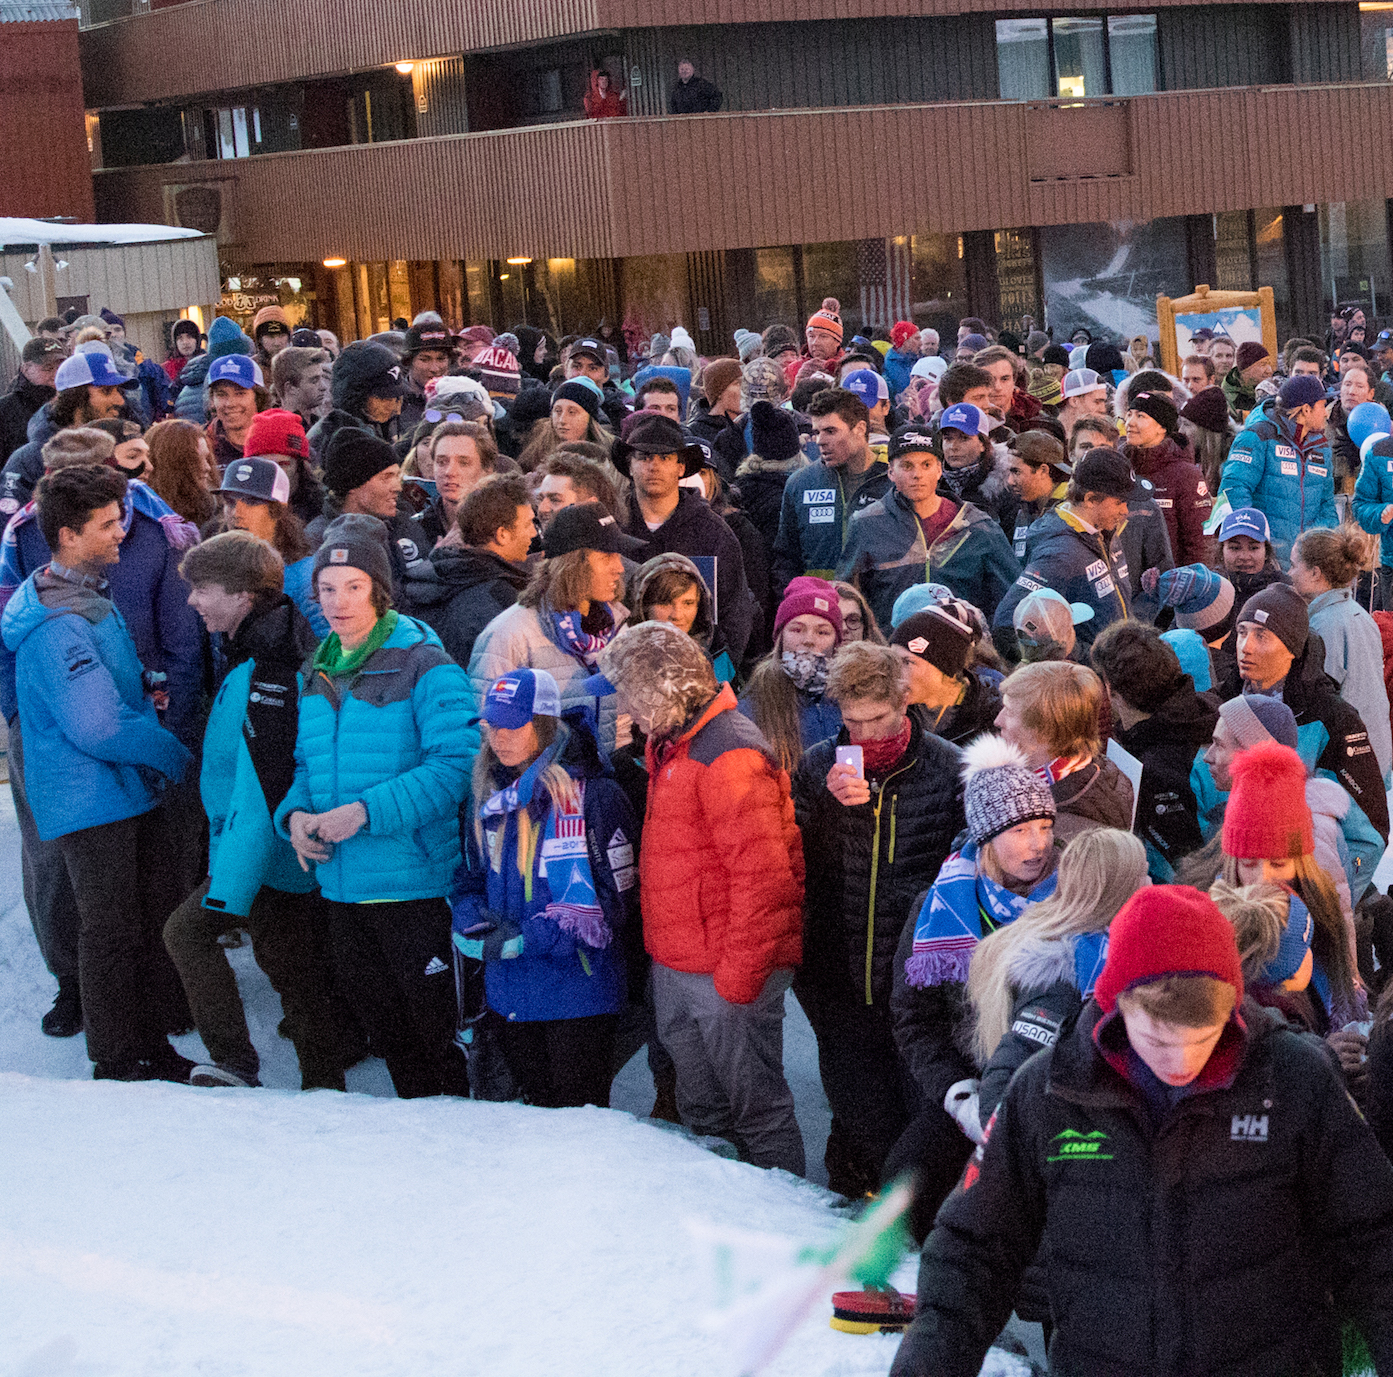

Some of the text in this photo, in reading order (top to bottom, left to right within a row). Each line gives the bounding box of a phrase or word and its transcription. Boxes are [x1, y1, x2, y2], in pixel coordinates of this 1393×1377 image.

[1277, 446, 1296, 457] VISA
[807, 490, 834, 502] VISA
[1088, 560, 1107, 578] VISA
[1018, 577, 1044, 591] USAN
